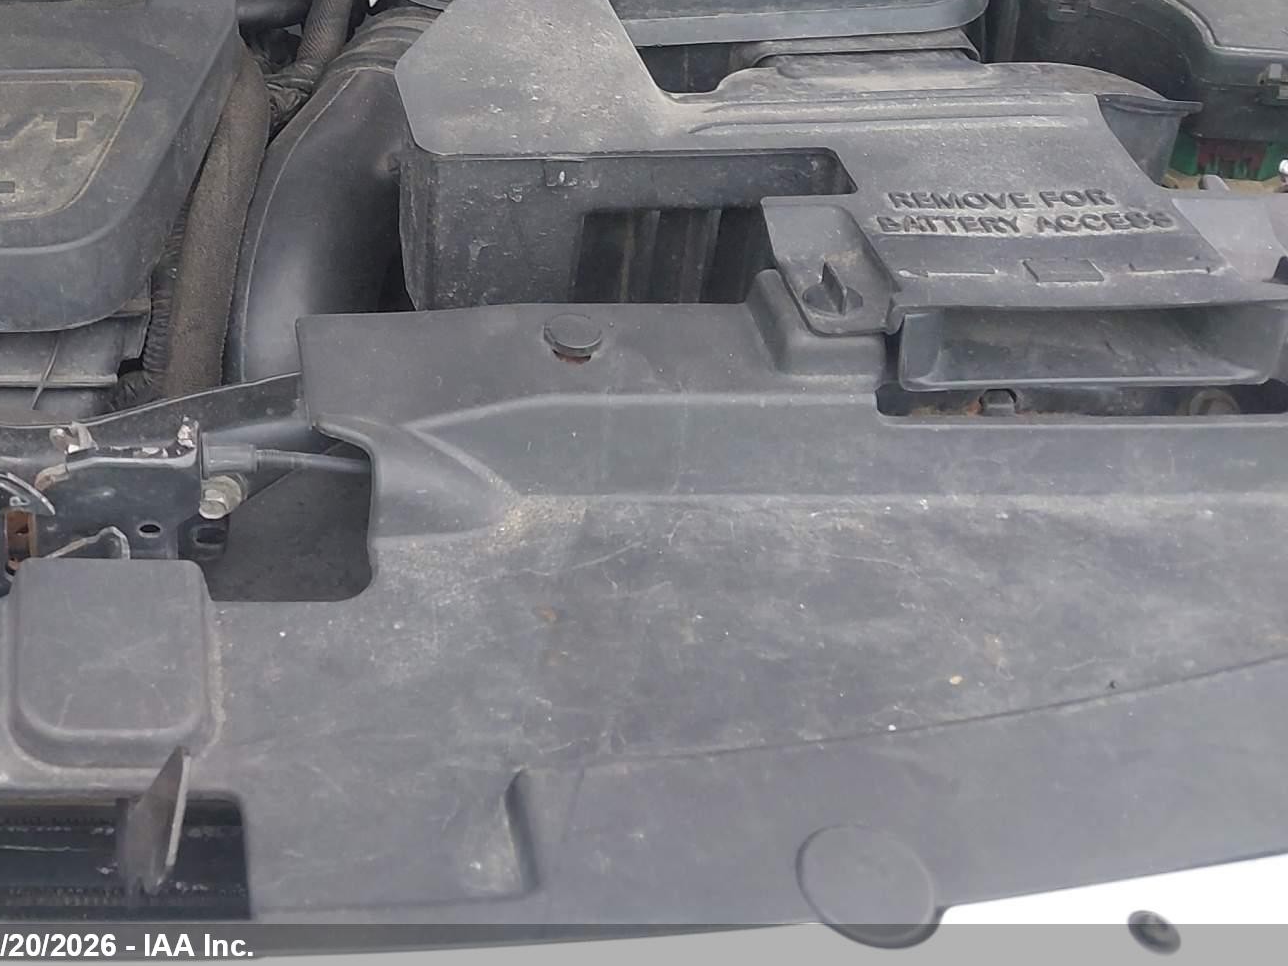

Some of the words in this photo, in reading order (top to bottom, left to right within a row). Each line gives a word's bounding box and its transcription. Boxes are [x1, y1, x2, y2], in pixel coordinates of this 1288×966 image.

[887, 191, 1035, 210] REMOVE
[1038, 188, 1116, 208] FOR
[875, 214, 1021, 234] BATTERY
[1037, 211, 1175, 233] ACCESS
